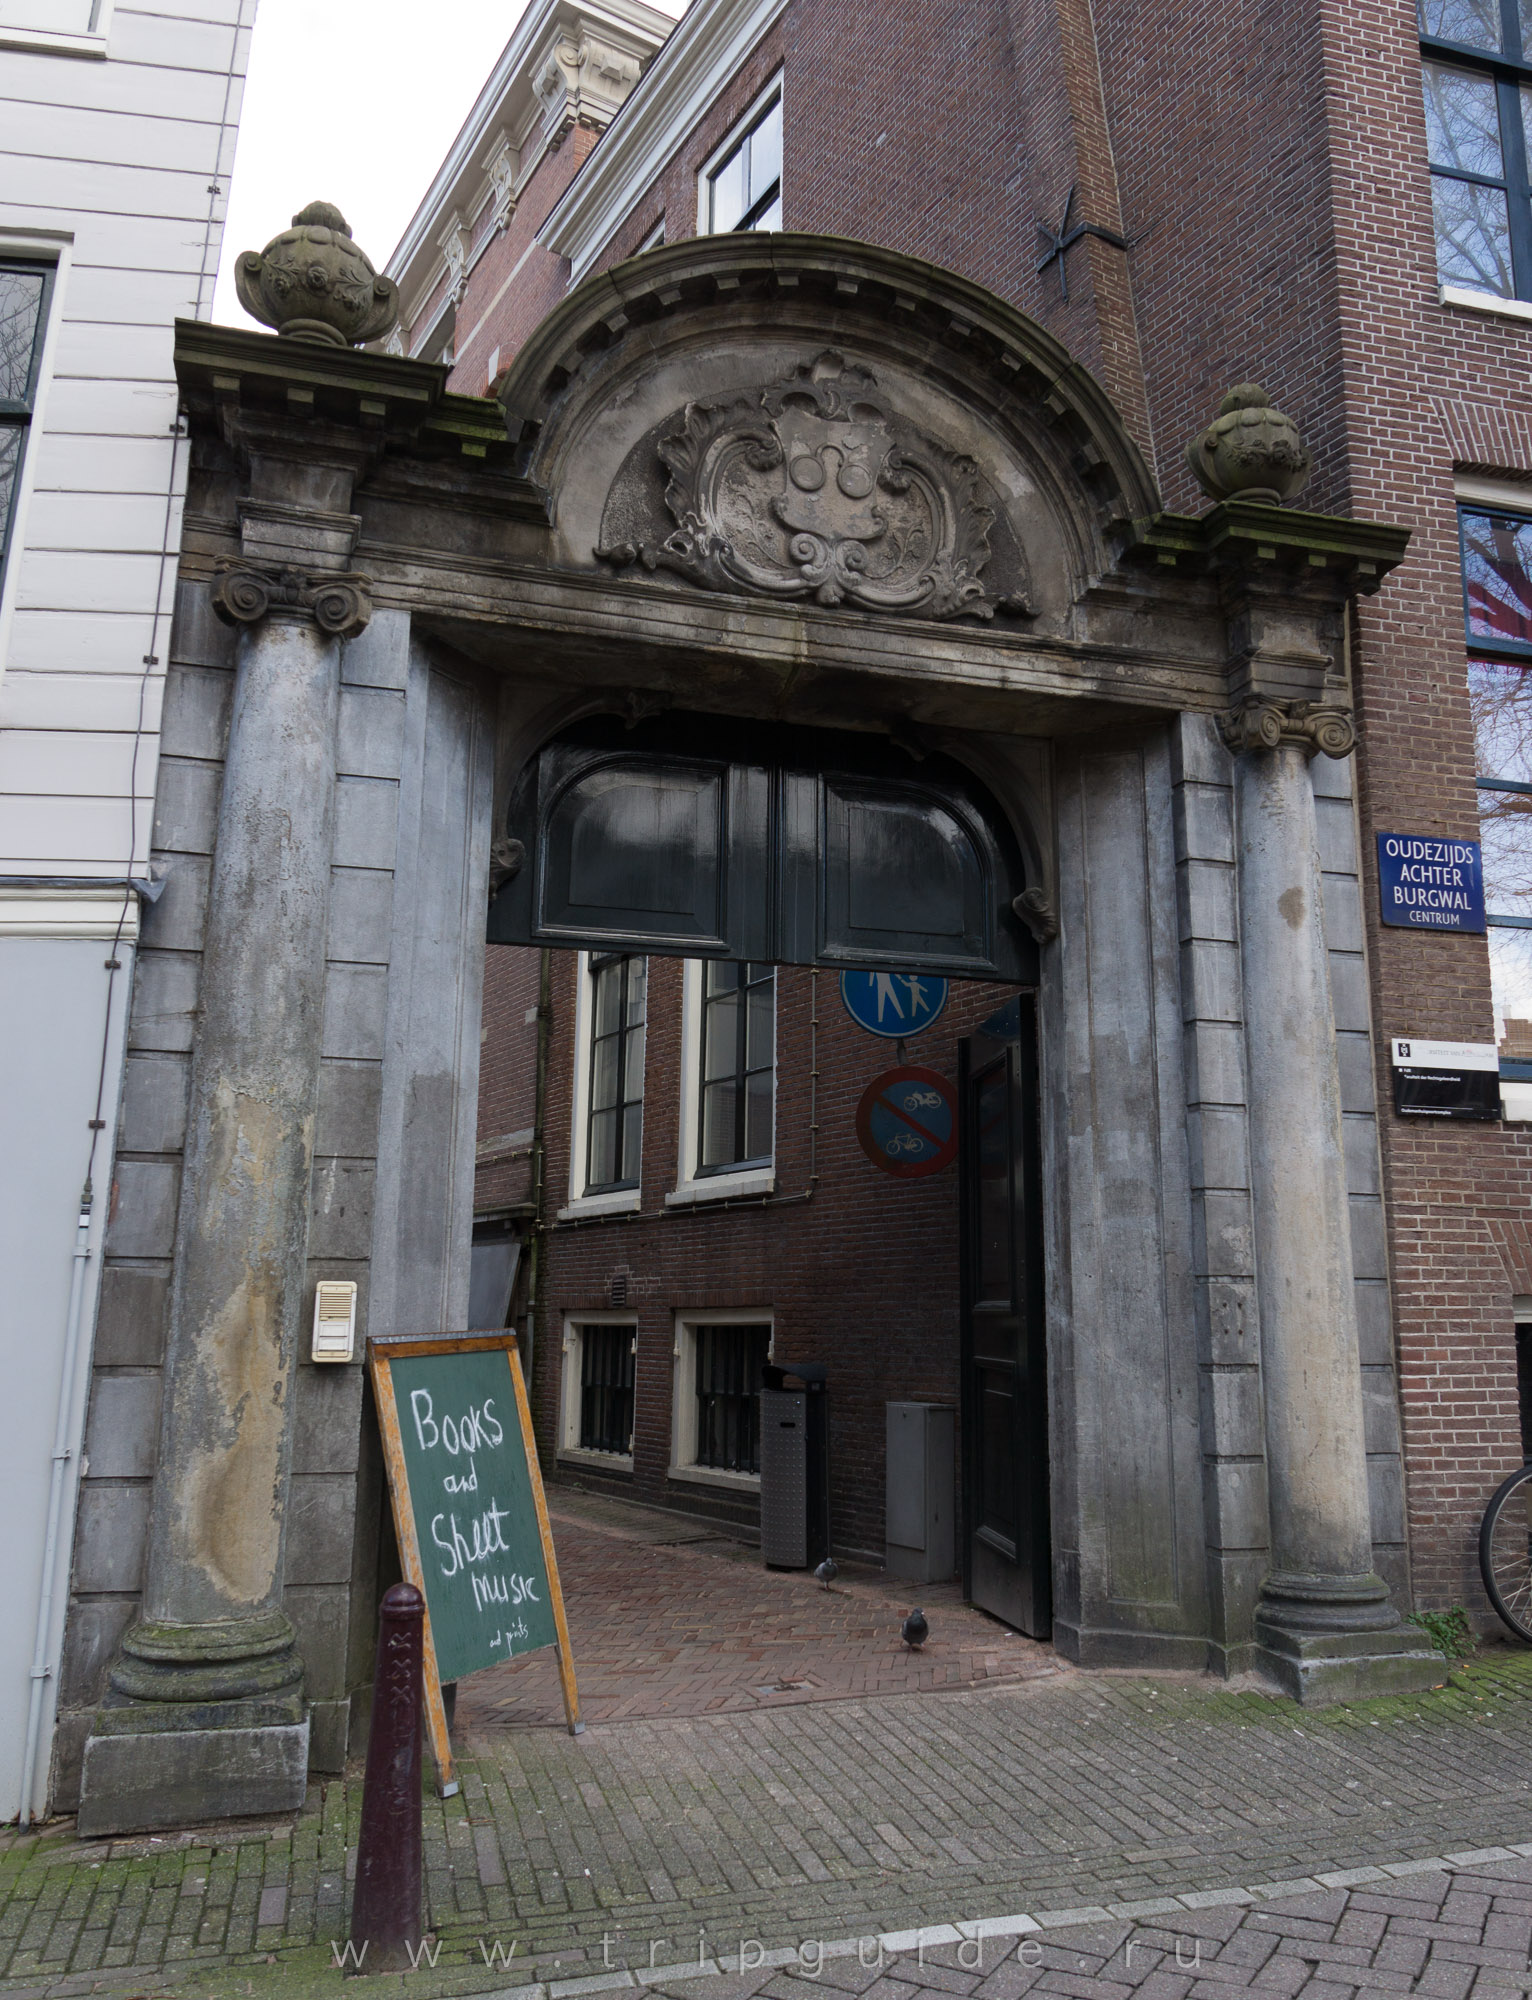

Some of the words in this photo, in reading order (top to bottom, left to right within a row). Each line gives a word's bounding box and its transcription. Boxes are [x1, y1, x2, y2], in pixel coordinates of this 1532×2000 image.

[1386, 839, 1474, 867] OUDEZIJDS
[1400, 864, 1464, 887] ACHTER
[1393, 886, 1472, 910] BURGWAL
[1409, 910, 1460, 925] CENTRUM
[443, 1456, 478, 1493] and
[431, 1496, 510, 1576] Sheet
[471, 1571, 541, 1612] music
